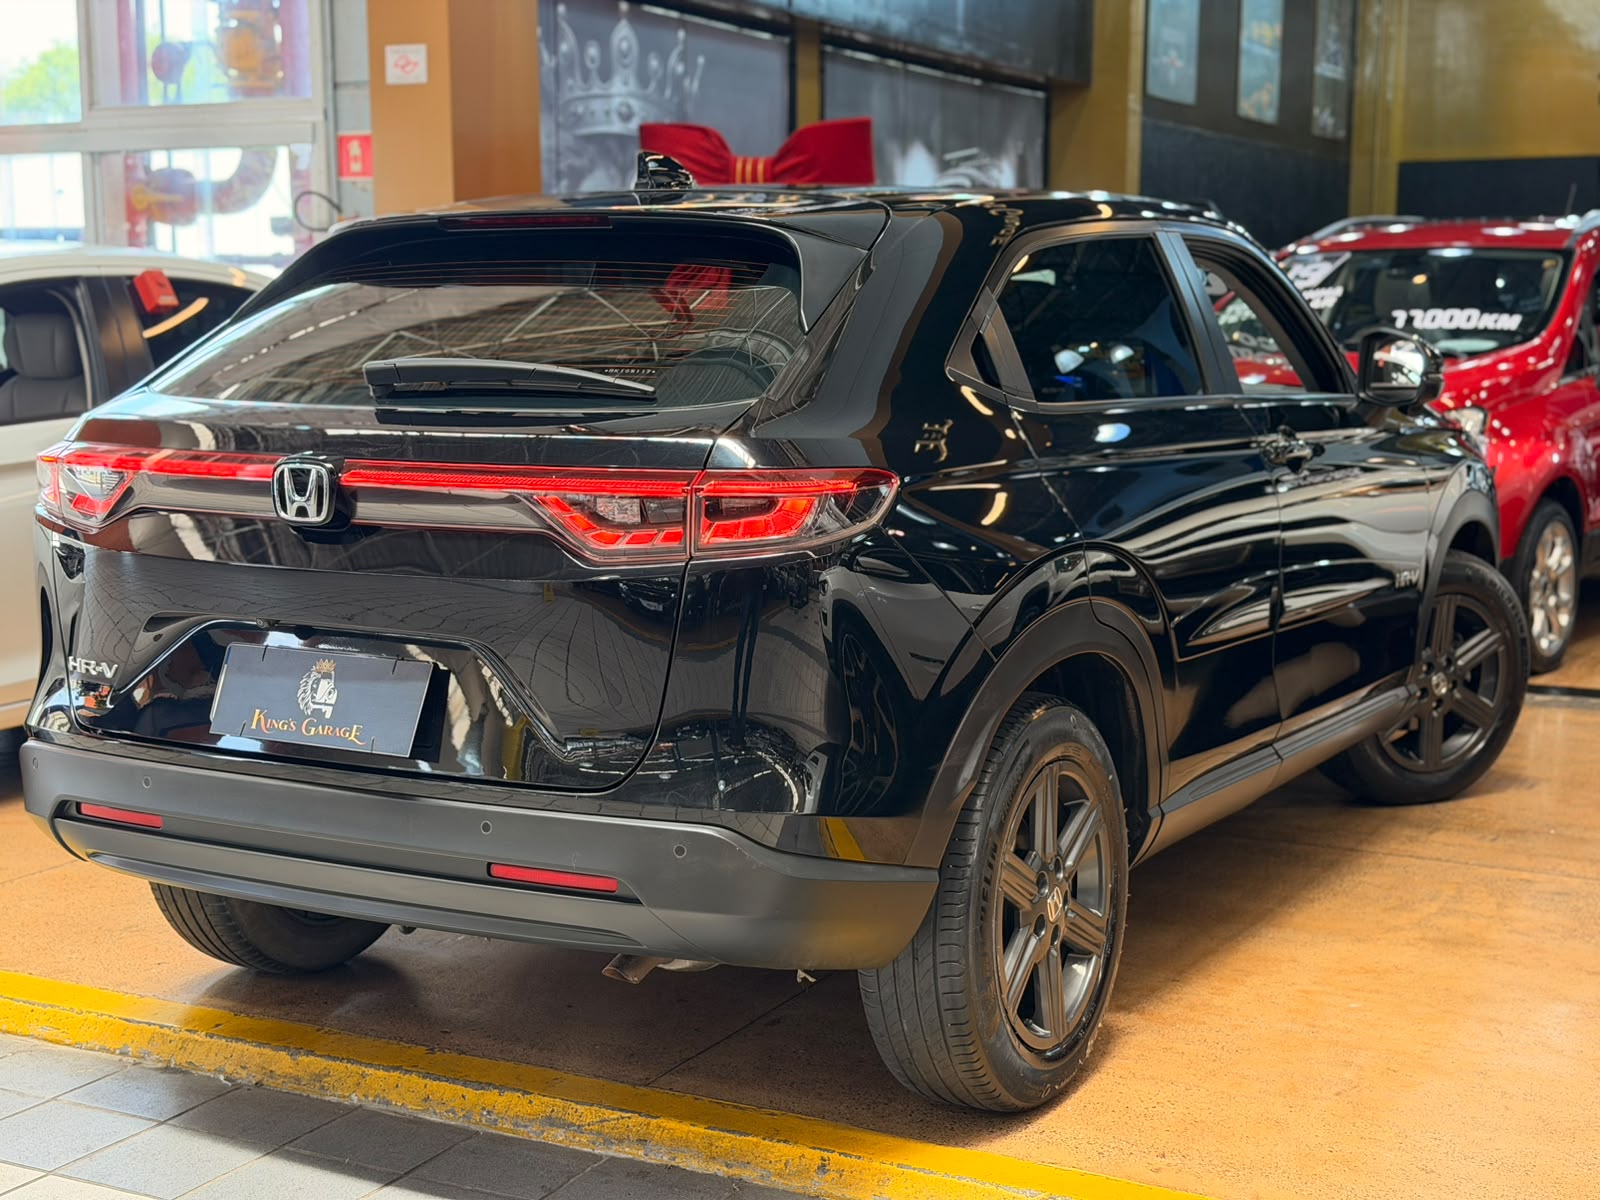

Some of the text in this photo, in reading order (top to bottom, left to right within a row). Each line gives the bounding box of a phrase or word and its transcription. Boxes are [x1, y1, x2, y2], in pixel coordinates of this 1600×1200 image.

[68, 655, 119, 679] HR-V
[250, 708, 368, 746] KING'S GARAGE
